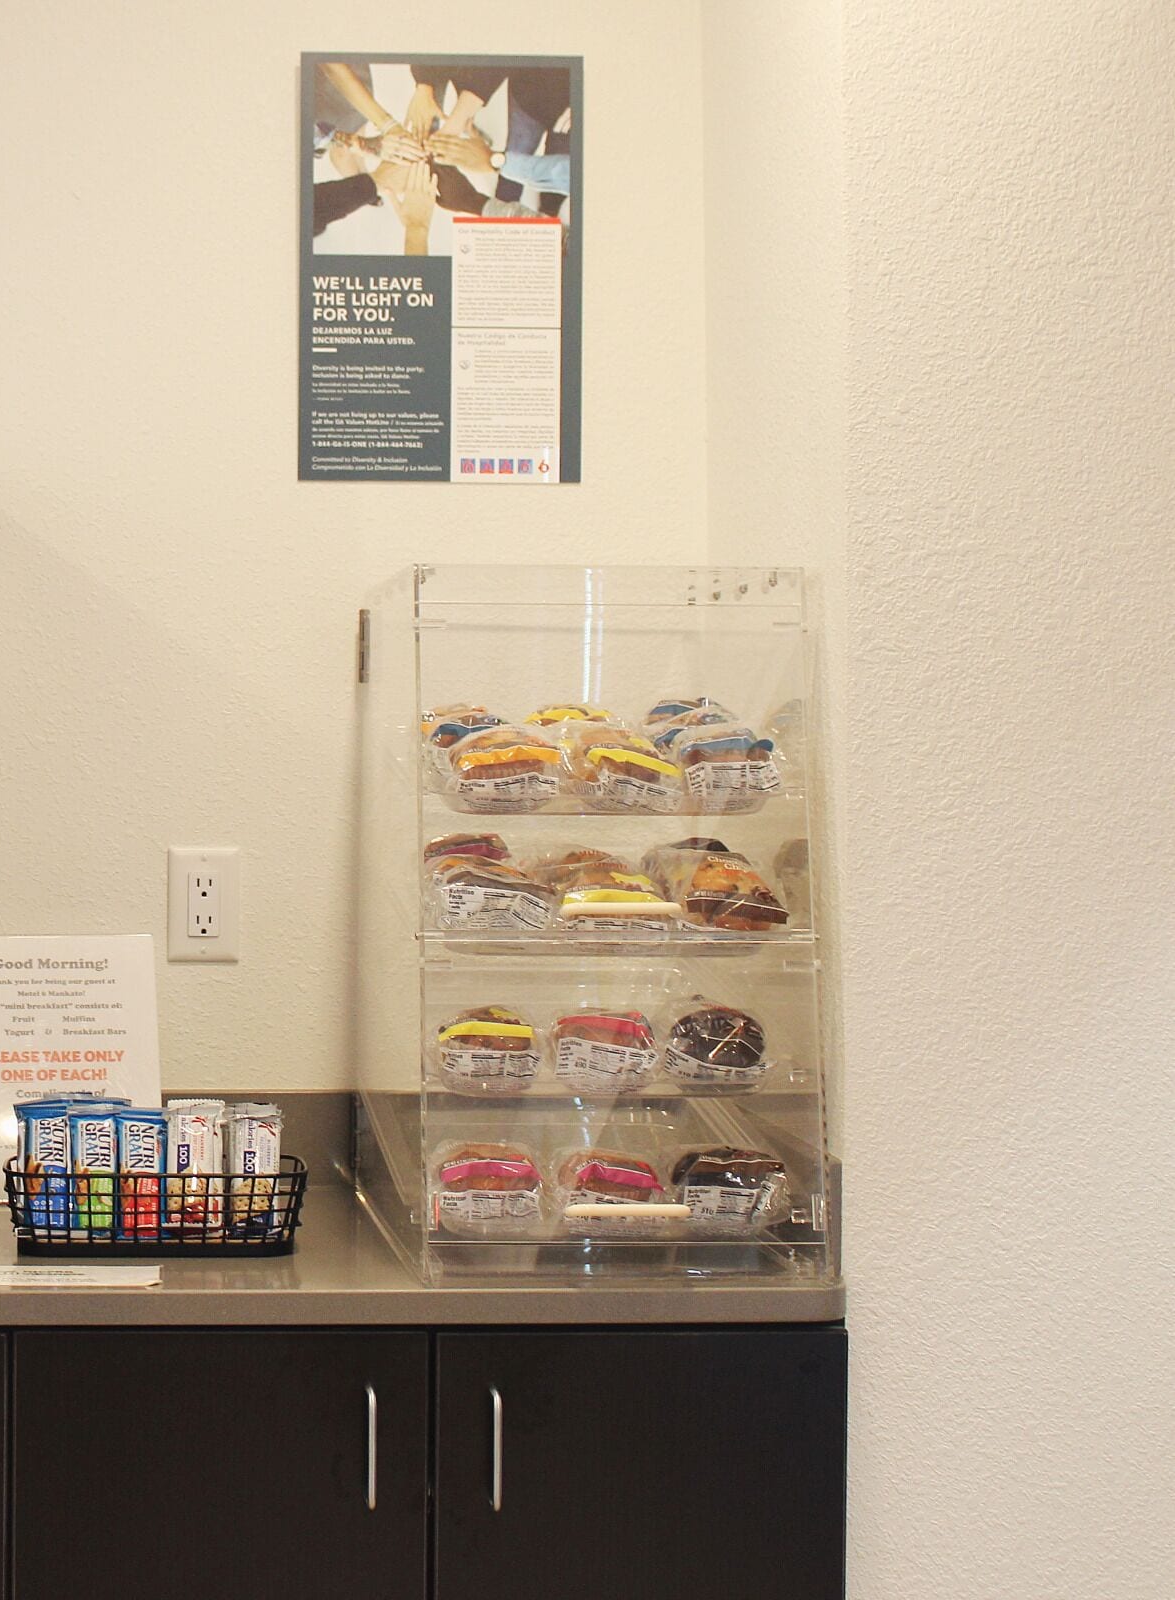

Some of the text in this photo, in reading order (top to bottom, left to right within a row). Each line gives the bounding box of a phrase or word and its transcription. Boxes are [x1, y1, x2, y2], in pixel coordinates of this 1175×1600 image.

[312, 276, 423, 290] WE'LL LEAVE
[312, 292, 434, 307] THE LIGHT ON
[312, 307, 395, 322] FOR YOU.
[312, 327, 393, 335] DEJAREMOS LA LUZ
[312, 336, 416, 345] ENCENDIDA PARA USTED.
[37, 958, 108, 971] Morning!
[4, 1029, 34, 1037] Yogurt
[42, 1051, 82, 1063] TAKE
[83, 1050, 125, 1062] ONLY
[0, 1068, 107, 1081] ONE OF EACH!
[39, 1120, 54, 1161] GRAIN
[52, 1118, 64, 1163] NUTRI
[85, 1123, 100, 1167] GRAIN
[96, 1123, 111, 1168] NUTRI
[129, 1124, 145, 1168] GRAIN
[140, 1125, 155, 1168] NUTRI
[179, 1146, 188, 1165] 100
[245, 1152, 254, 1172] 100
